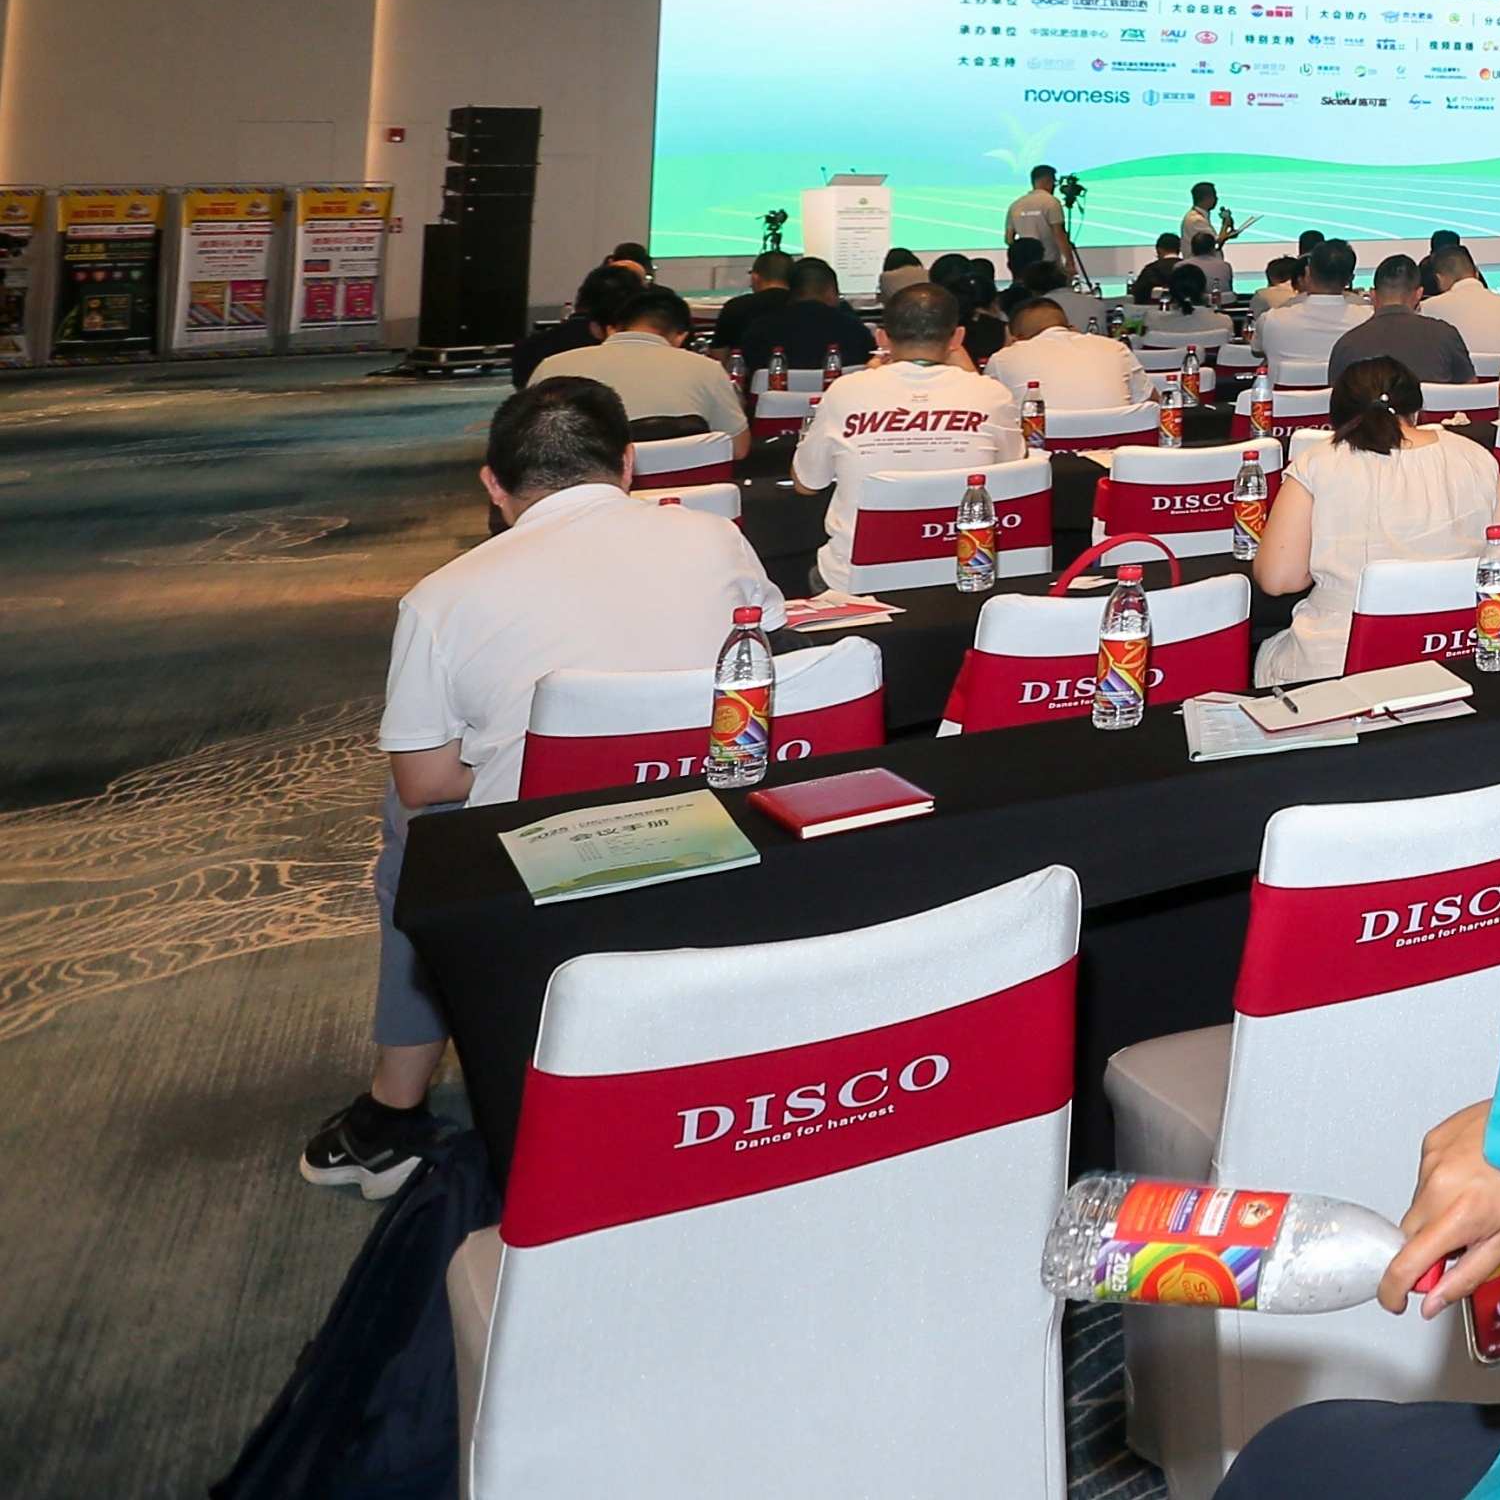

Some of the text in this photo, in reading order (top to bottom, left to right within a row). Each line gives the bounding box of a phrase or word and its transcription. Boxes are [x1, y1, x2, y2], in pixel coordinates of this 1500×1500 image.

[1024, 88, 1131, 104] novonesis
[921, 513, 1022, 539] DIO
[1018, 668, 1165, 704] DISO
[1048, 701, 1079, 710] Dance
[569, 818, 669, 842] 会议手册
[1395, 933, 1435, 948] Dance
[1438, 927, 1457, 939] for
[673, 1053, 951, 1150] DISCO
[734, 1104, 896, 1152] Dance for harvest
[1112, 1252, 1132, 1293] 2025
